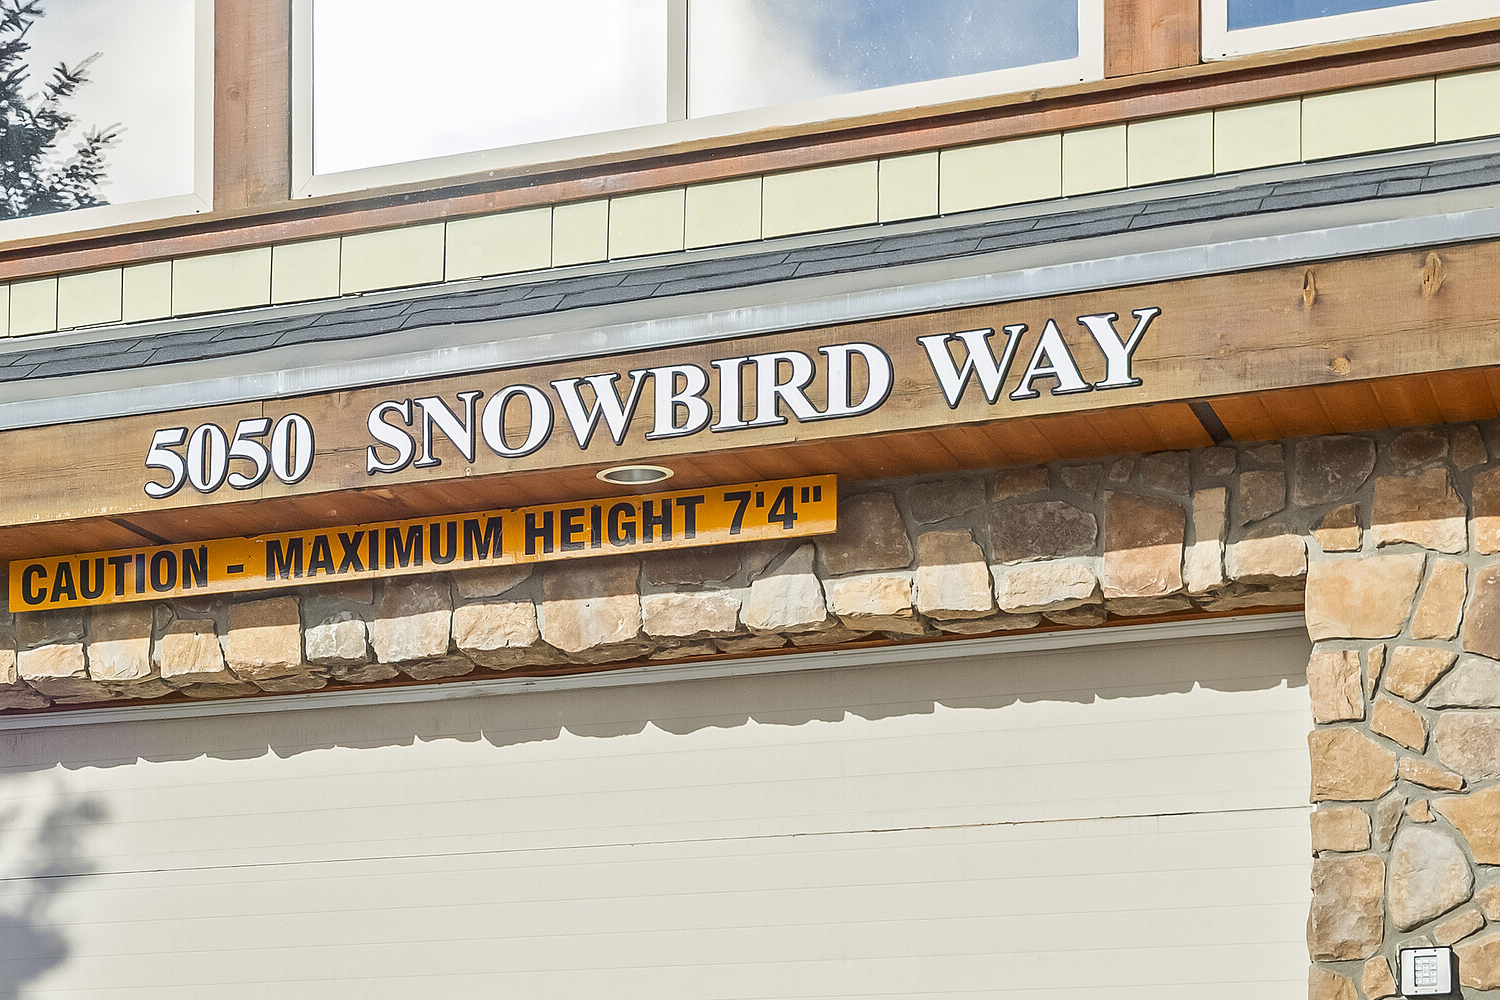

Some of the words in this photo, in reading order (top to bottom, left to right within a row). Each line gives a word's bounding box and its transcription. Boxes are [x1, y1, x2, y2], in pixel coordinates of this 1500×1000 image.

[144, 413, 315, 499] 5050
[366, 342, 895, 474] SNOWBIRD
[917, 306, 1162, 410] WAY
[21, 546, 209, 605] CAUTION
[265, 516, 503, 581] MAXIMUM
[524, 494, 705, 556] HEIGHT
[729, 484, 822, 536] 7'4"
